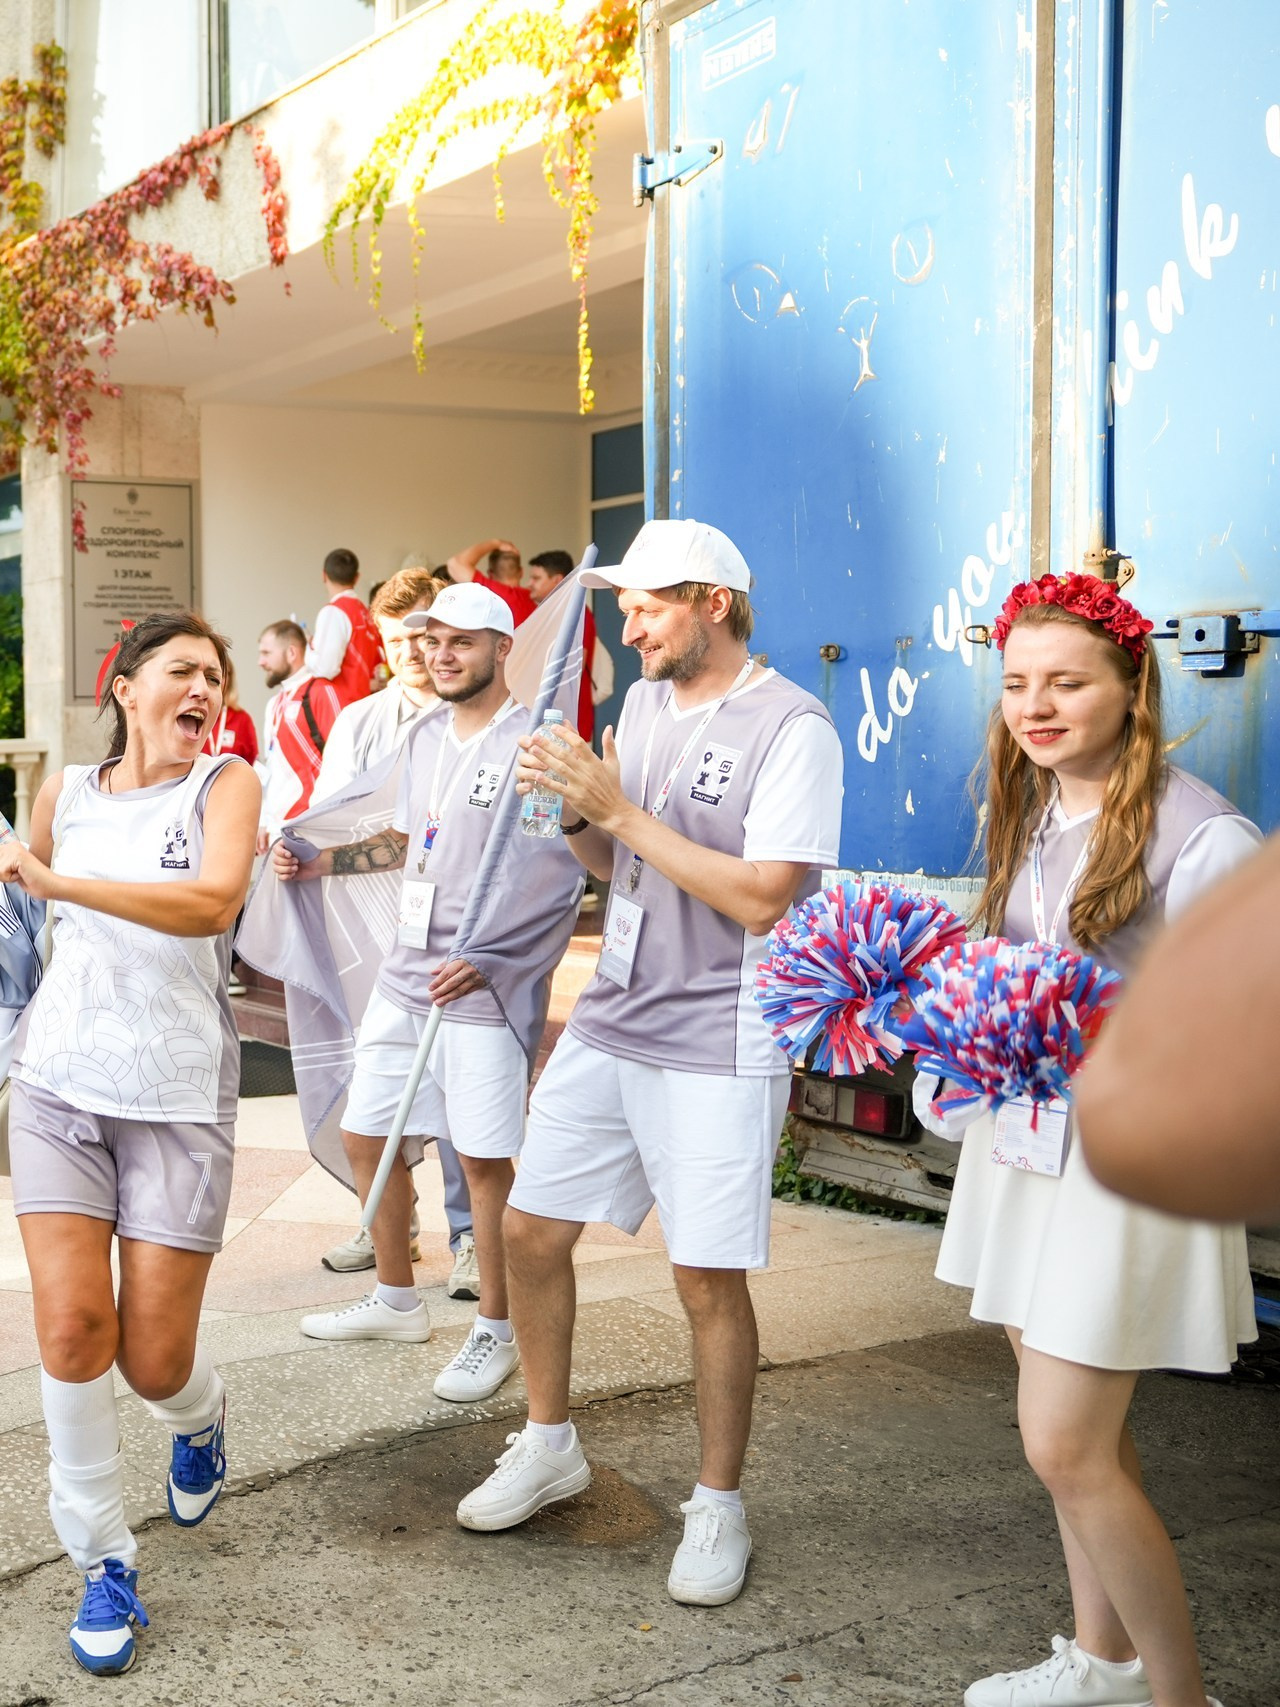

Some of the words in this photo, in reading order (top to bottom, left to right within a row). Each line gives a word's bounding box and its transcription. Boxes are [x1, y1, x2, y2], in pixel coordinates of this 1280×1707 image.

[101, 526, 165, 537] СПОРТИВНО-
[106, 550, 160, 559] КОМПЛЕКС
[114, 569, 119, 578] 1
[121, 569, 152, 579] ЭТАЖ
[856, 665, 919, 763] do
[933, 511, 1024, 667] you
[693, 792, 716, 803] МАГНИТ
[187, 1151, 213, 1225] 7
